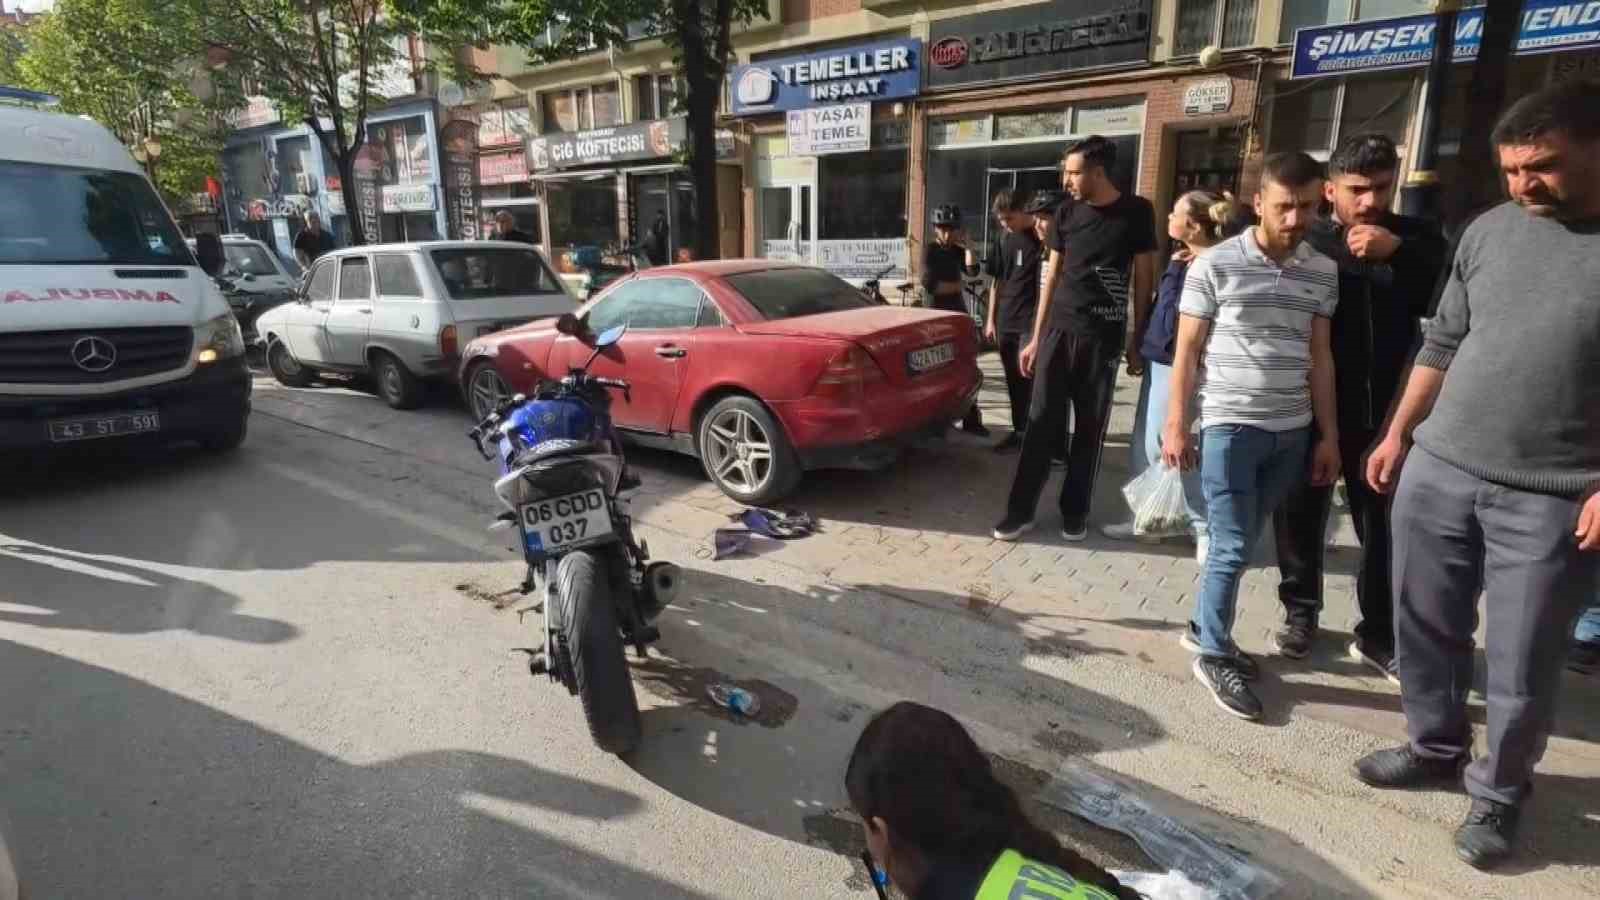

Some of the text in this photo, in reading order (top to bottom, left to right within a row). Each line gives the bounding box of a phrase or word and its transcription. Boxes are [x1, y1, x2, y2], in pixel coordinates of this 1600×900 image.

[1309, 23, 1437, 60] ŞİMŞEK
[781, 46, 909, 84] TEMELLER
[810, 79, 880, 101] İNŞAAT
[813, 126, 865, 142] TEMEL
[63, 414, 158, 436] 43 ST 591
[526, 492, 602, 525] 06 CDD
[550, 518, 588, 543] 037
